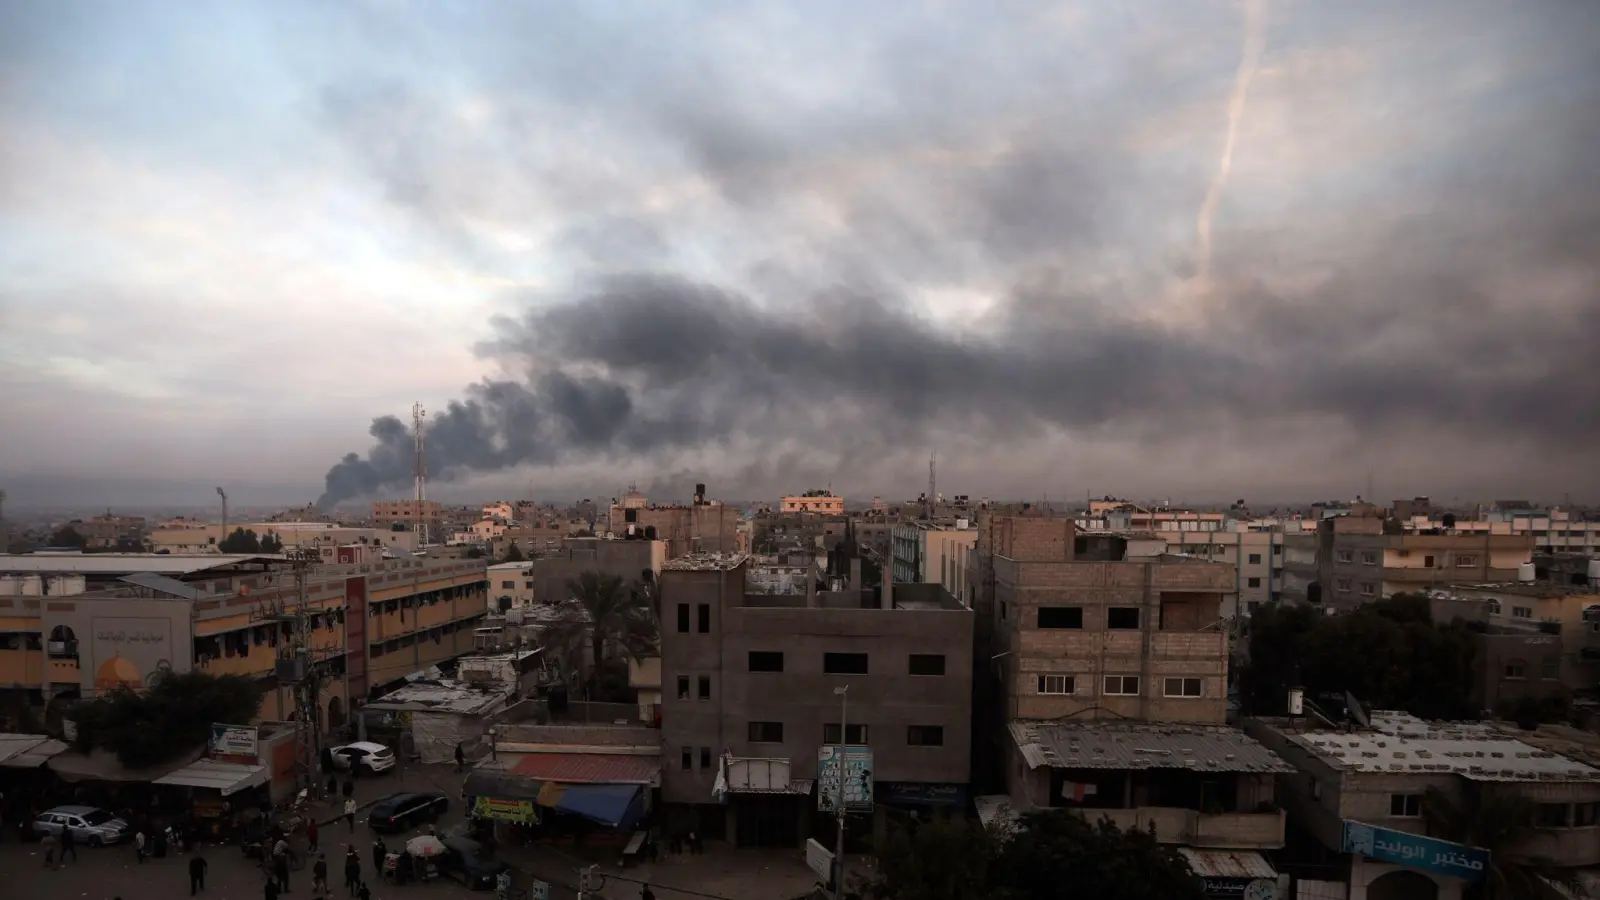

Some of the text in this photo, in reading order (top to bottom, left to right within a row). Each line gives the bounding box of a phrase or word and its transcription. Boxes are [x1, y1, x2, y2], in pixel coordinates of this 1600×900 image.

[1375, 839, 1484, 871] مختبر الوليد
[1207, 880, 1245, 893] صيدلية
